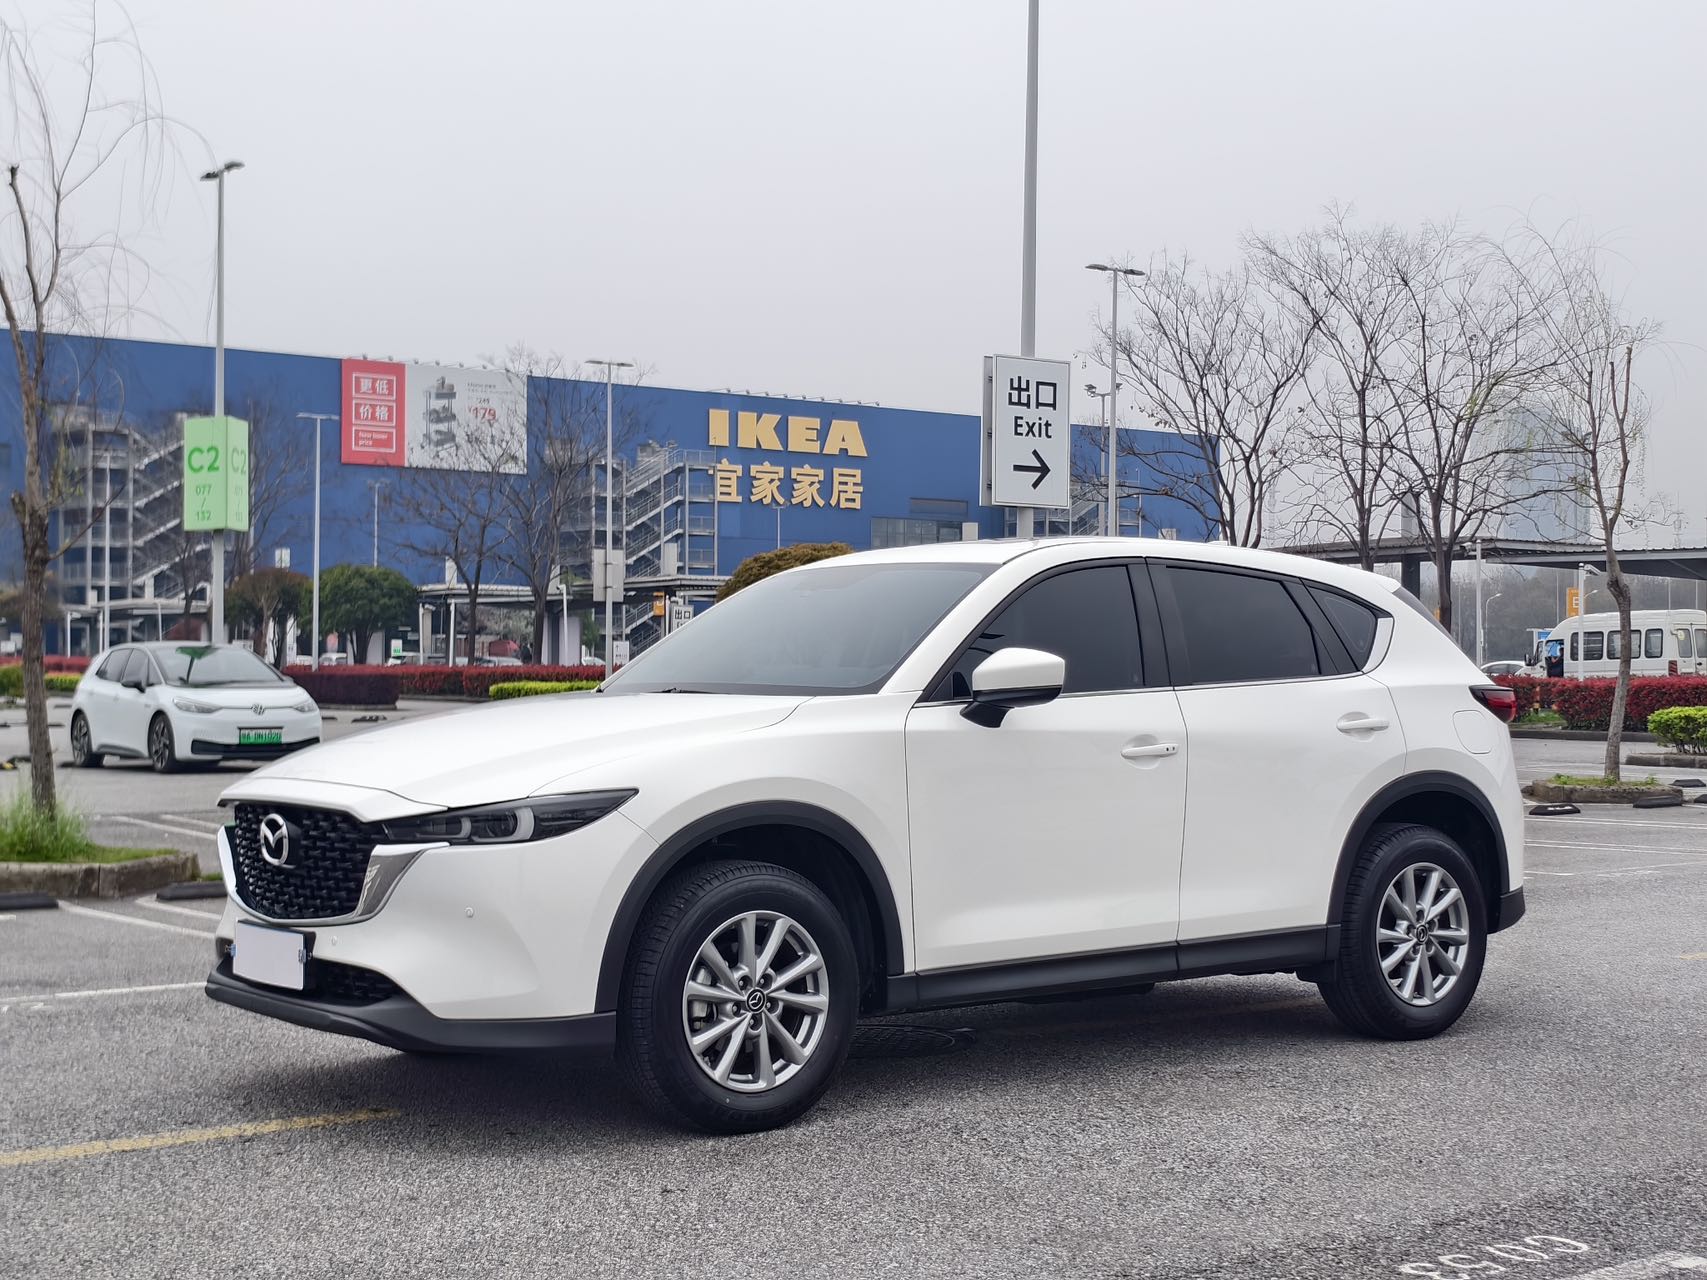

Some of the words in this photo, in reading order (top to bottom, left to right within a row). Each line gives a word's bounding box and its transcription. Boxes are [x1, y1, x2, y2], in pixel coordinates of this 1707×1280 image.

[360, 377, 389, 395] 更低
[1008, 375, 1057, 411] 出口
[360, 404, 389, 421] 价格
[709, 408, 868, 457] IKEA
[1013, 415, 1052, 439] Exit
[188, 446, 220, 473] C2
[231, 447, 247, 475] C2
[195, 484, 212, 496] 077
[709, 458, 863, 510] 宜家家居
[674, 609, 691, 620] 出口
